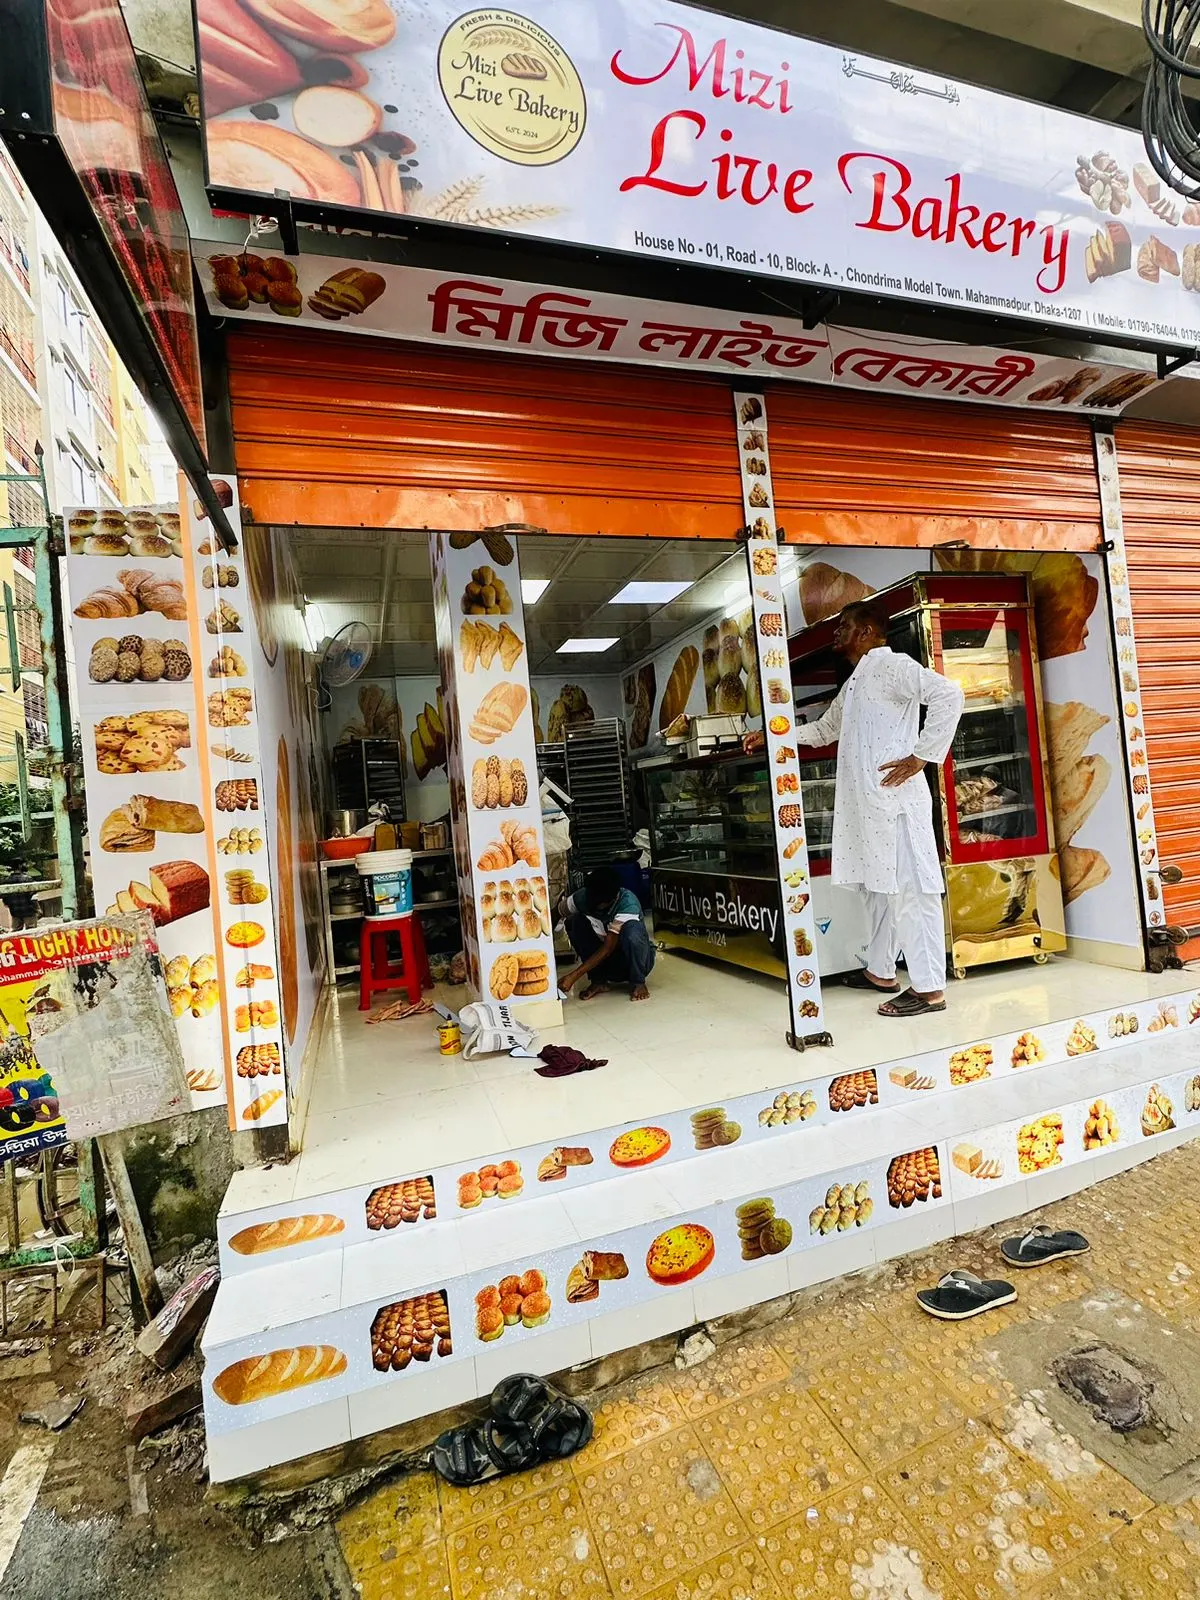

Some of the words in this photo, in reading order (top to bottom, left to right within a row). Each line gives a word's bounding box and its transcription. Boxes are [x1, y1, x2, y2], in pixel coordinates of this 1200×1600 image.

[451, 51, 497, 77] Mizi
[459, 14, 493, 32] FRESH
[505, 16, 561, 57] DELICIOUS
[610, 22, 793, 114] Mizi
[454, 75, 503, 106] Live
[508, 87, 580, 134] Bakery
[522, 129, 538, 138] 2024
[619, 109, 815, 214] Live
[837, 152, 1071, 294] Bakery
[634, 231, 675, 251] House
[677, 238, 695, 254] No
[706, 243, 723, 261] 01,
[726, 246, 756, 265] Road
[767, 253, 784, 271] 10,
[823, 263, 832, 278] A
[846, 267, 902, 290] Chondrima
[904, 277, 933, 295] Model
[965, 288, 1033, 314] Mahammadpur,
[1034, 301, 1082, 321] Dhaka-1207
[427, 280, 629, 352] মিজি
[638, 320, 830, 368] লাইভ
[831, 347, 1036, 397] বেকারী
[653, 883, 679, 913] Mizi
[681, 887, 711, 920] Live
[715, 892, 778, 942] Bakery
[706, 929, 727, 947] 2024
[20, 930, 77, 960] LIGHT
